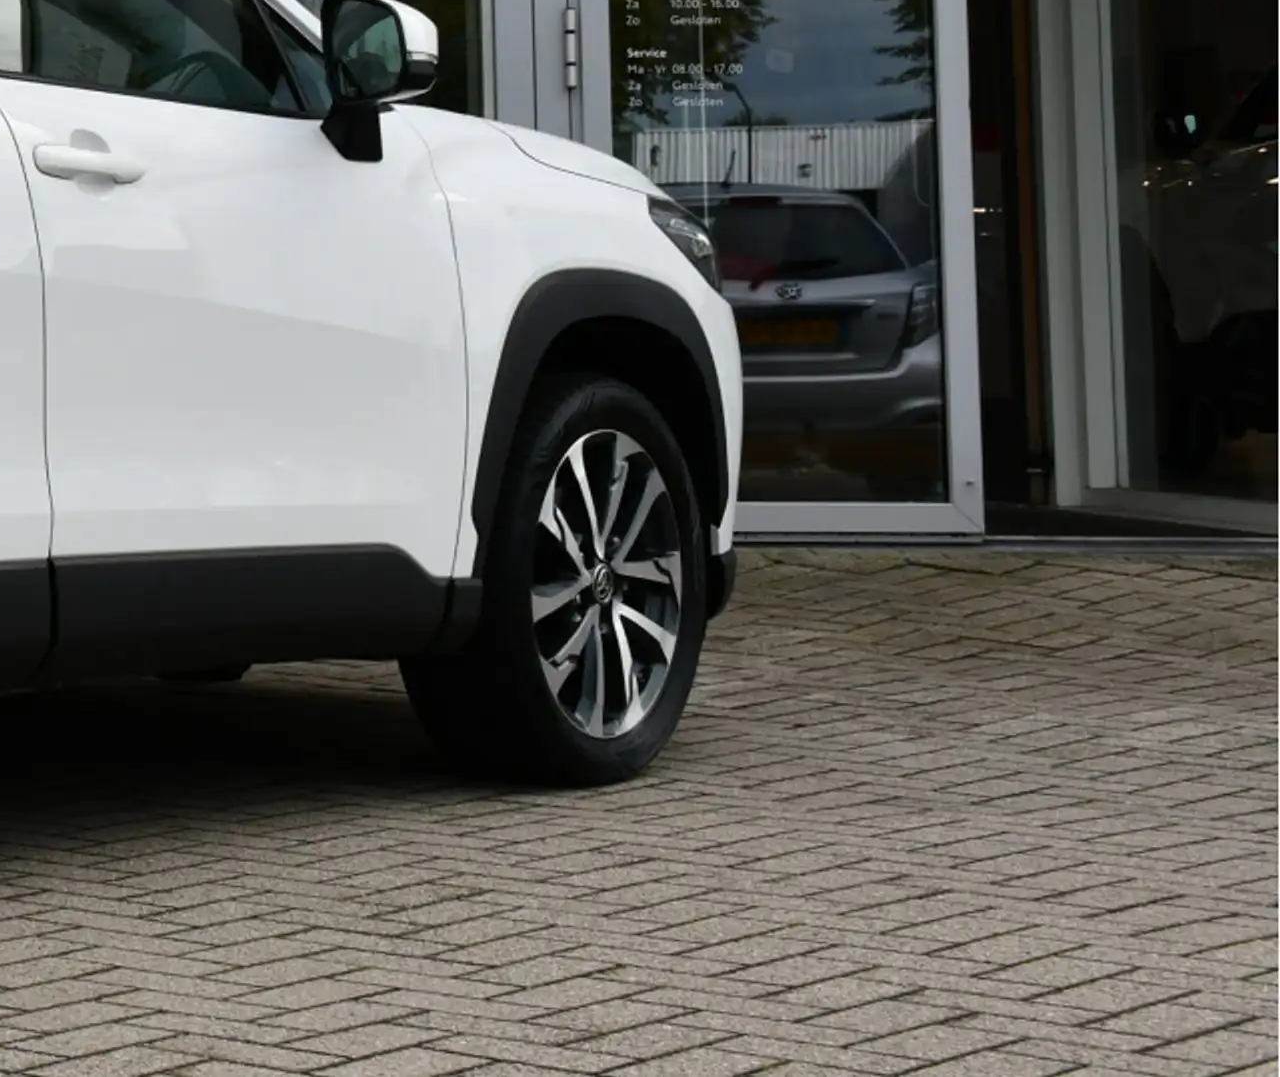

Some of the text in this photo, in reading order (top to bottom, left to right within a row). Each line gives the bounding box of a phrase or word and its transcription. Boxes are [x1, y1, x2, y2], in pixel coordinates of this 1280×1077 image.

[626, 0, 639, 9] Za
[626, 15, 721, 25] Zo Gesloten
[627, 48, 667, 58] Service
[628, 65, 644, 74] Ma
[654, 64, 666, 74] Vr
[628, 80, 723, 91] Za Gesloten
[629, 97, 723, 107] Zo Gesloten
